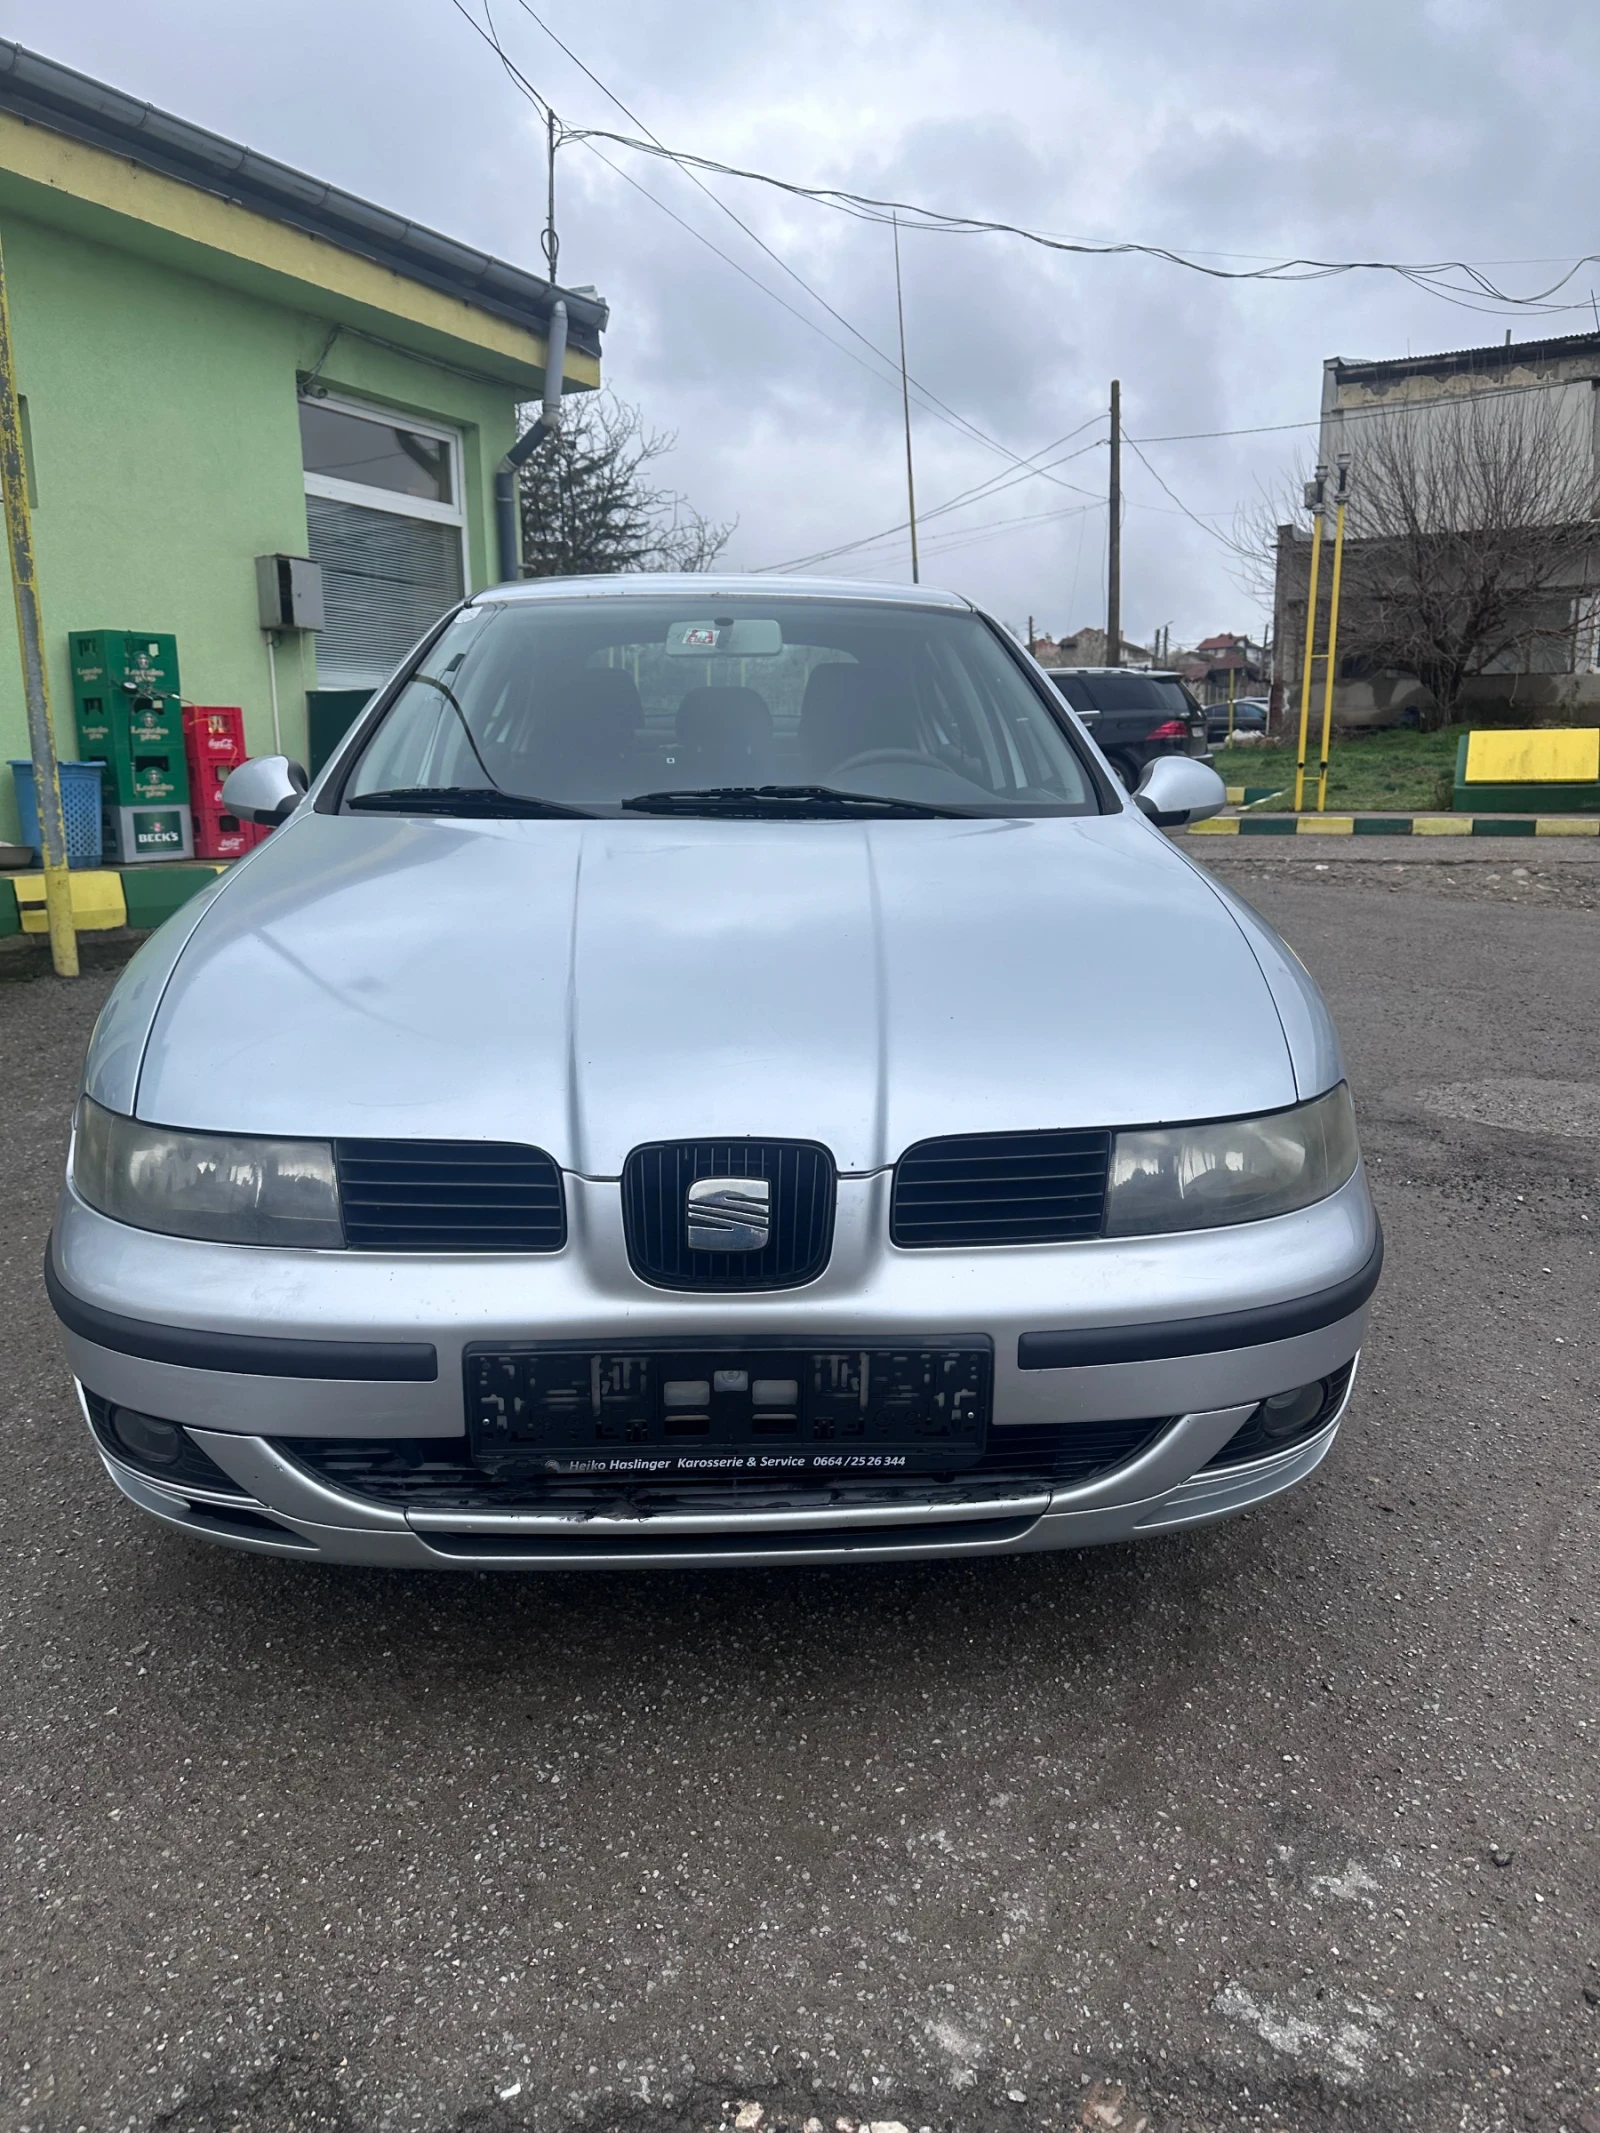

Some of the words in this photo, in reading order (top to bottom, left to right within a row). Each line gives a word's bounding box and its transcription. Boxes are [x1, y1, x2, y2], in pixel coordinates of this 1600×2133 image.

[138, 831, 179, 843] BECK'S
[569, 1460, 606, 1471] Heiko
[609, 1459, 671, 1471] Haslinger
[677, 1457, 744, 1468] Karosserie
[746, 1456, 757, 1467] &
[760, 1456, 806, 1467] Service
